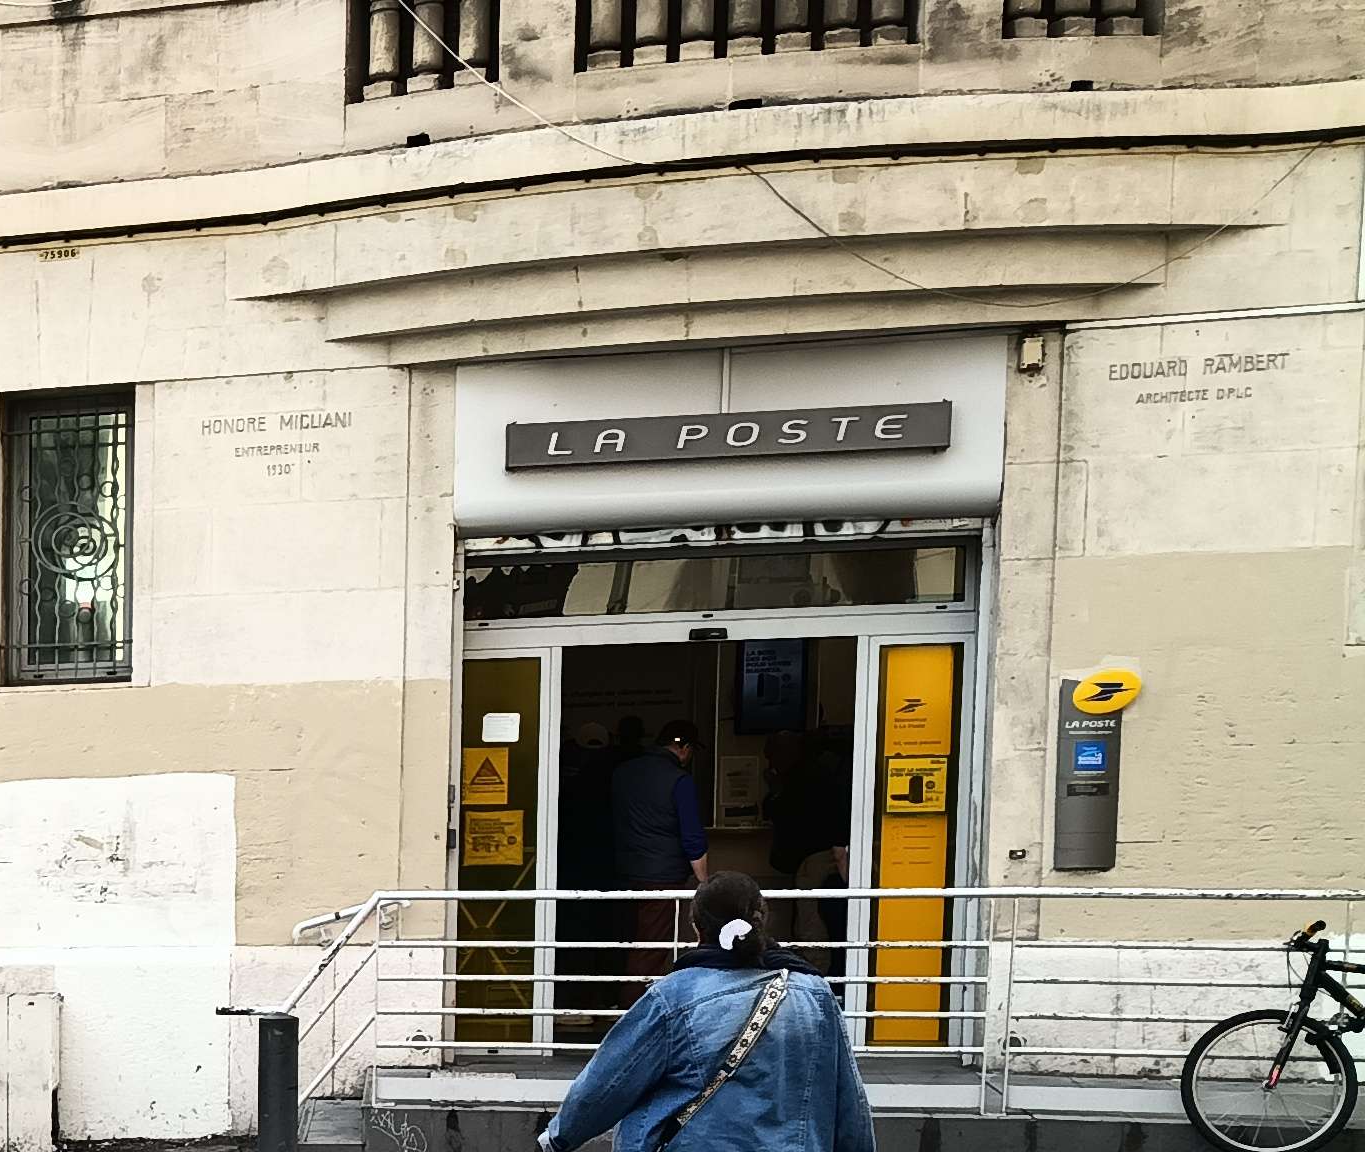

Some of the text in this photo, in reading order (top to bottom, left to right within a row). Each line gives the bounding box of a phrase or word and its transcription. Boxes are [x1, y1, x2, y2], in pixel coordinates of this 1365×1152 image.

[1108, 352, 1290, 381] EDOUARD RAMBERT
[1135, 388, 1209, 404] ARCHITECTE
[547, 413, 909, 456] LA POSTE
[234, 442, 320, 458] ENTREPRENEUR
[1082, 719, 1117, 728] POSTE
